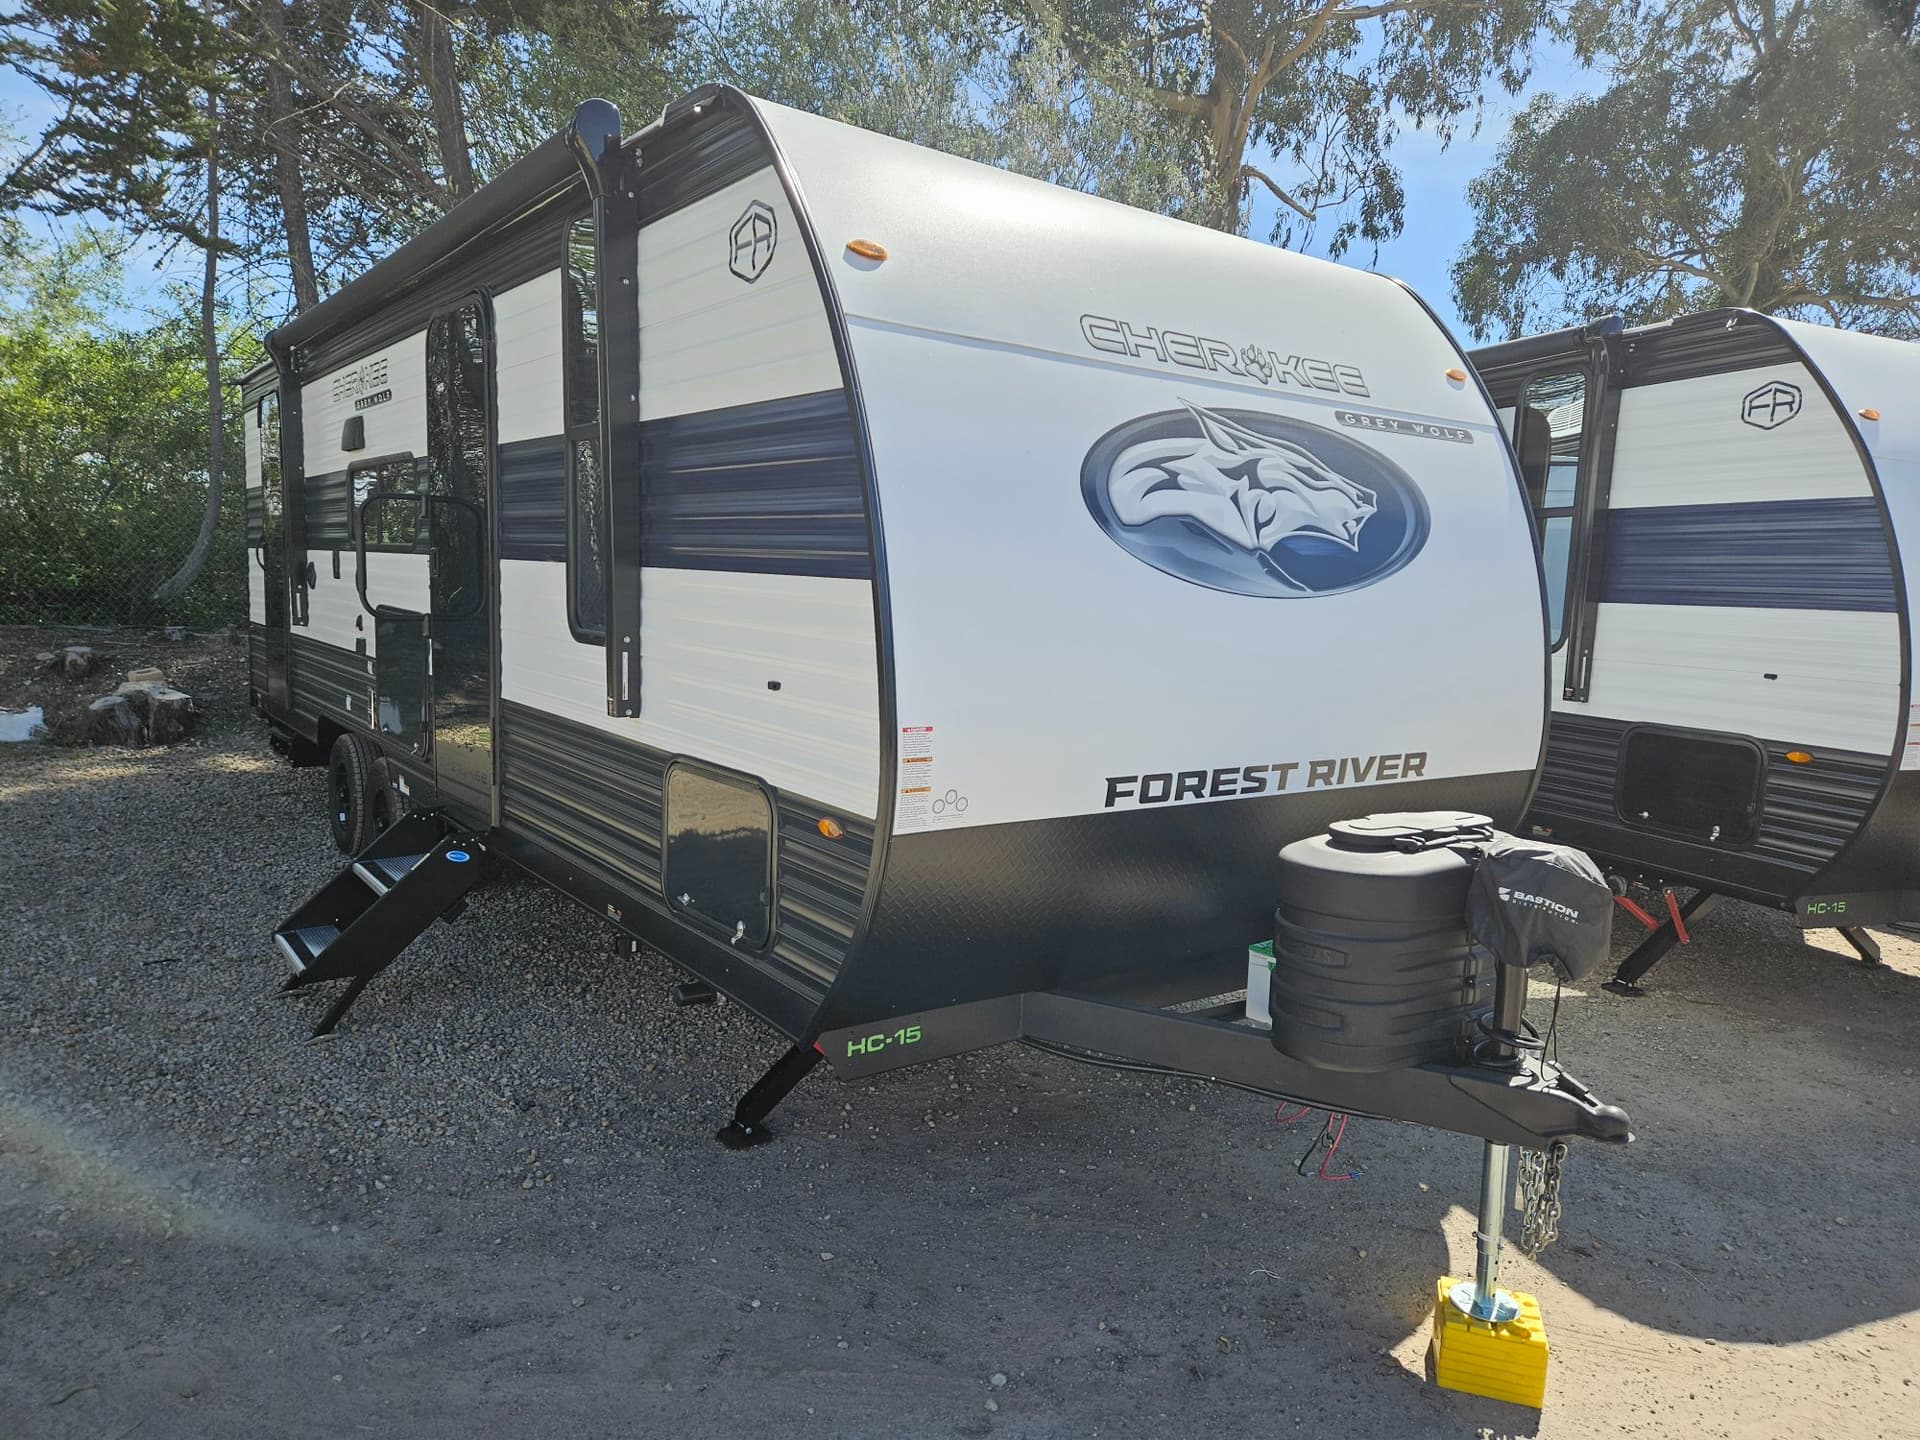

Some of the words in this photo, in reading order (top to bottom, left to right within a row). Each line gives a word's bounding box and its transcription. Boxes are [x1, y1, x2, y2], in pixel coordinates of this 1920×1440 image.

[1344, 413, 1399, 430] GREY
[1412, 423, 1465, 440] WOLF
[1104, 762, 1299, 807] FOREST
[1307, 751, 1427, 788] RIVER
[1513, 891, 1579, 918] BASTION
[847, 1025, 922, 1057] HC-15
